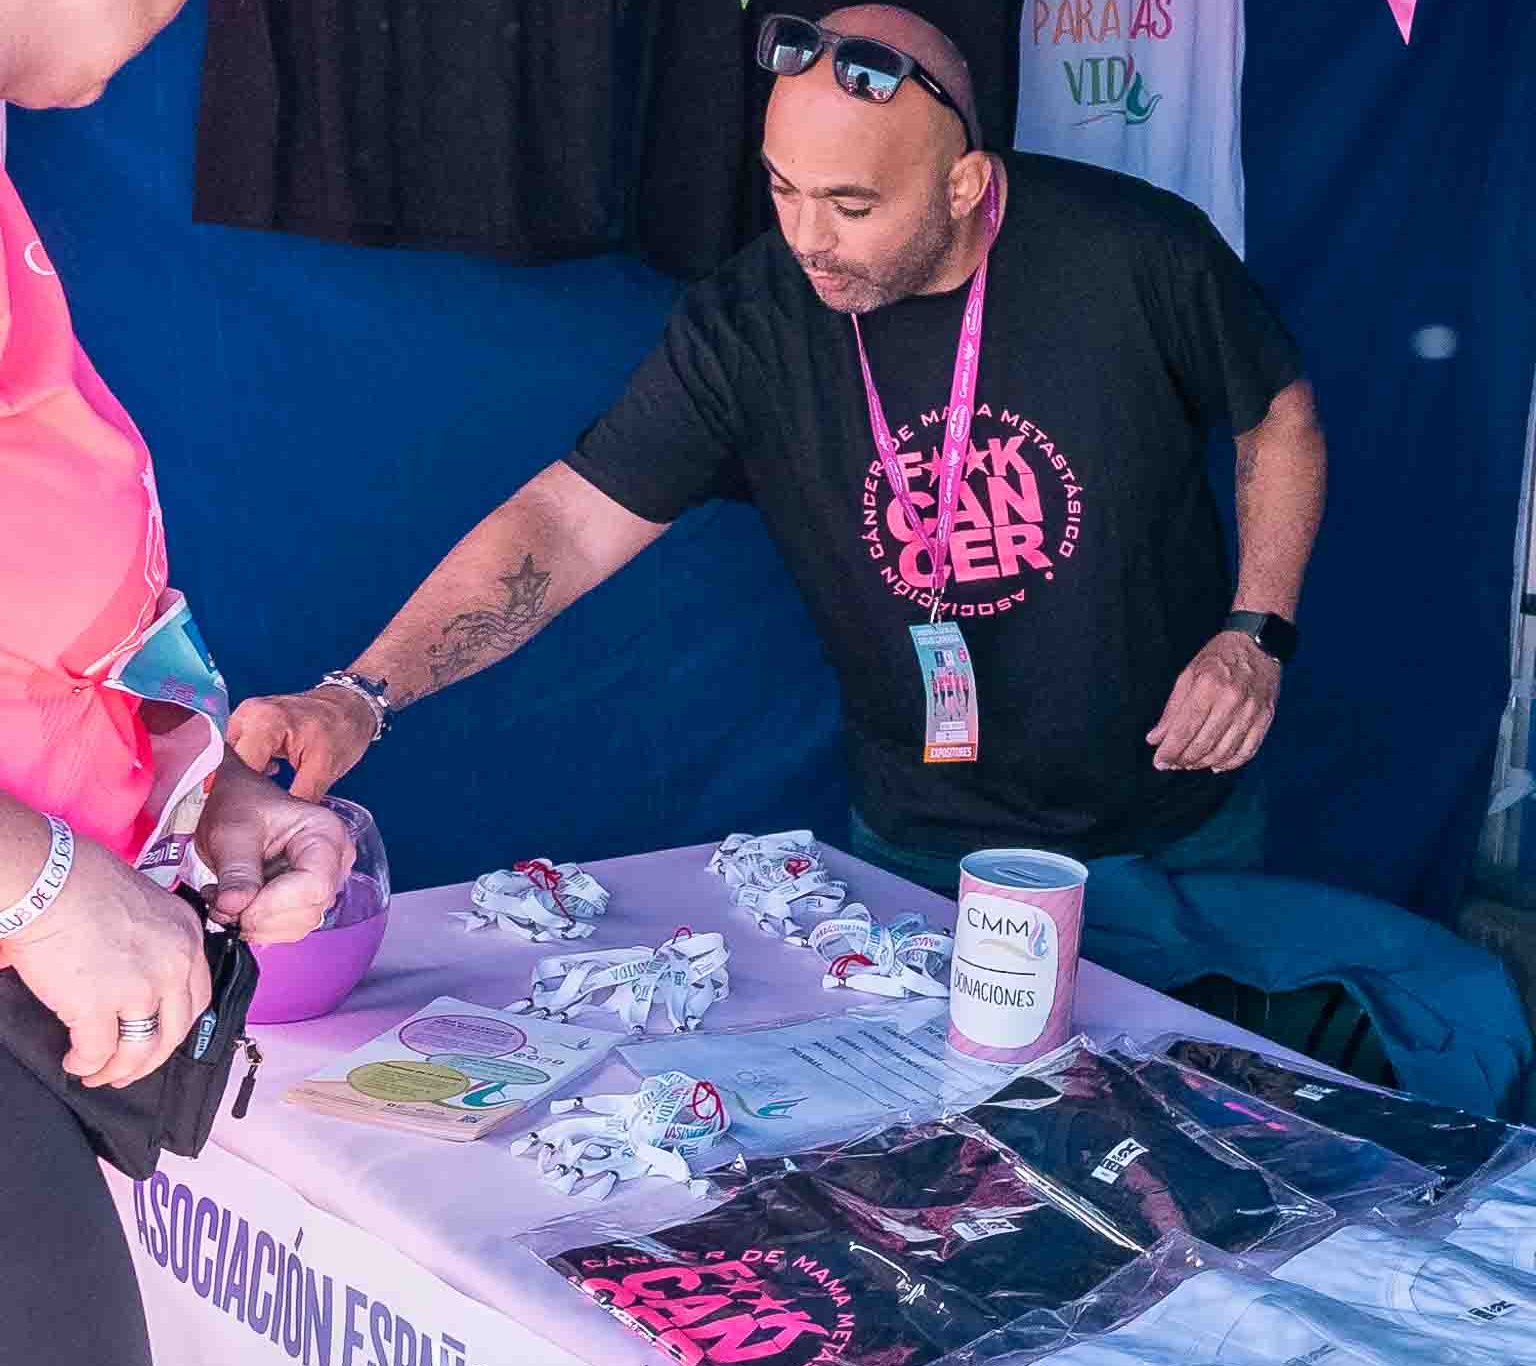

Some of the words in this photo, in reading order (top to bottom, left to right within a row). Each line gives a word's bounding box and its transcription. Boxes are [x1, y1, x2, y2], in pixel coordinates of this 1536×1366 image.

[885, 473, 1045, 543] CAN
[920, 403, 993, 428] MAA
[1000, 409, 1084, 559] METASTÁSICO
[898, 522, 1054, 589] CER
[966, 906, 1031, 938] CMM
[953, 968, 1036, 1009] DONACIONES
[741, 1248, 787, 1264] DE
[791, 1254, 857, 1309] MAMA
